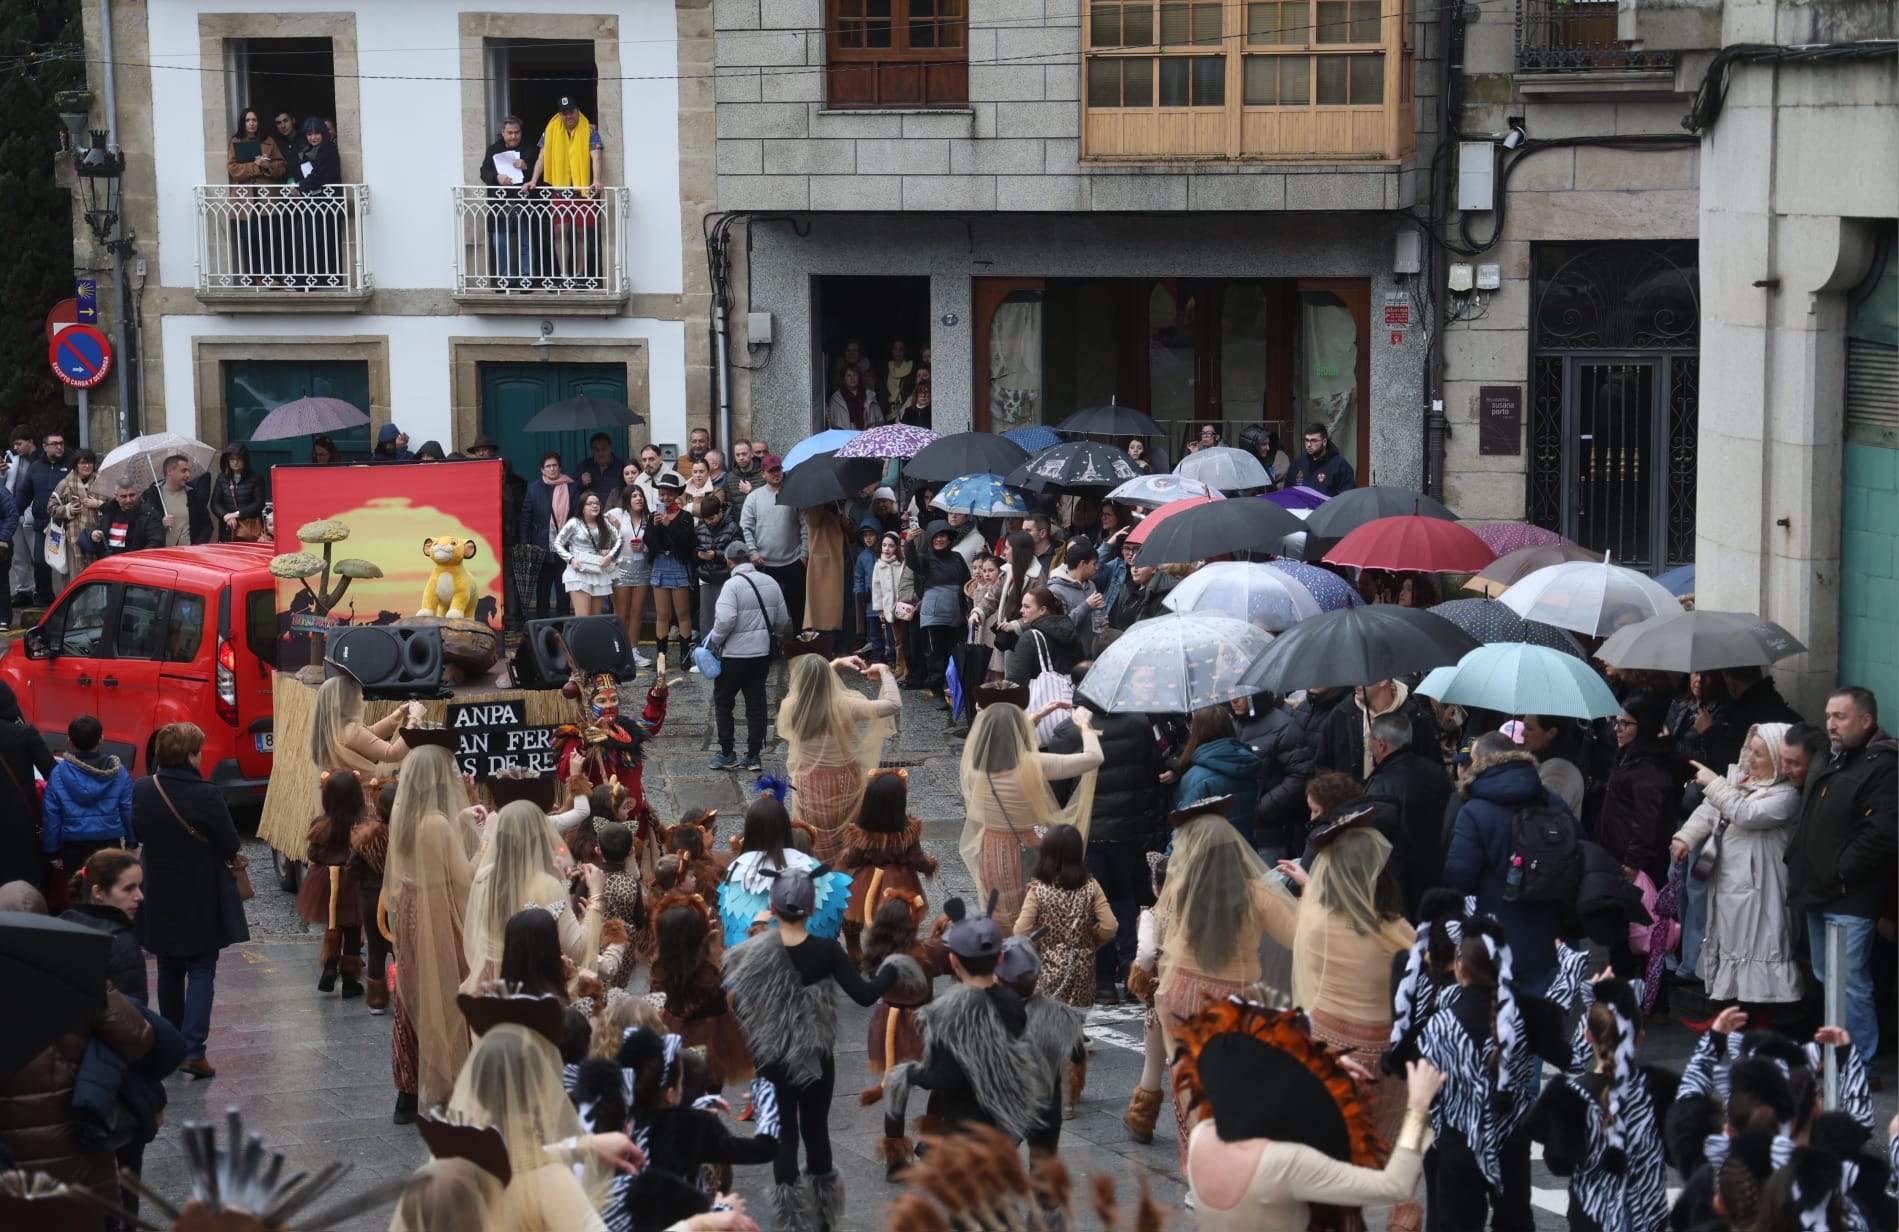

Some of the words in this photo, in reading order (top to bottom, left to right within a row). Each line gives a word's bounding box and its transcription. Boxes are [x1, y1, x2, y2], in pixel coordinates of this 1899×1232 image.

[52, 362, 71, 383] EXCEPTO
[70, 379, 89, 387] CARGA
[92, 356, 109, 382] DESCARGA
[1491, 408, 1510, 417] porto
[454, 704, 518, 728] ANPA
[455, 732, 490, 754] AN
[506, 729, 556, 751] FER
[487, 754, 519, 776] DE
[527, 751, 558, 772] RE
